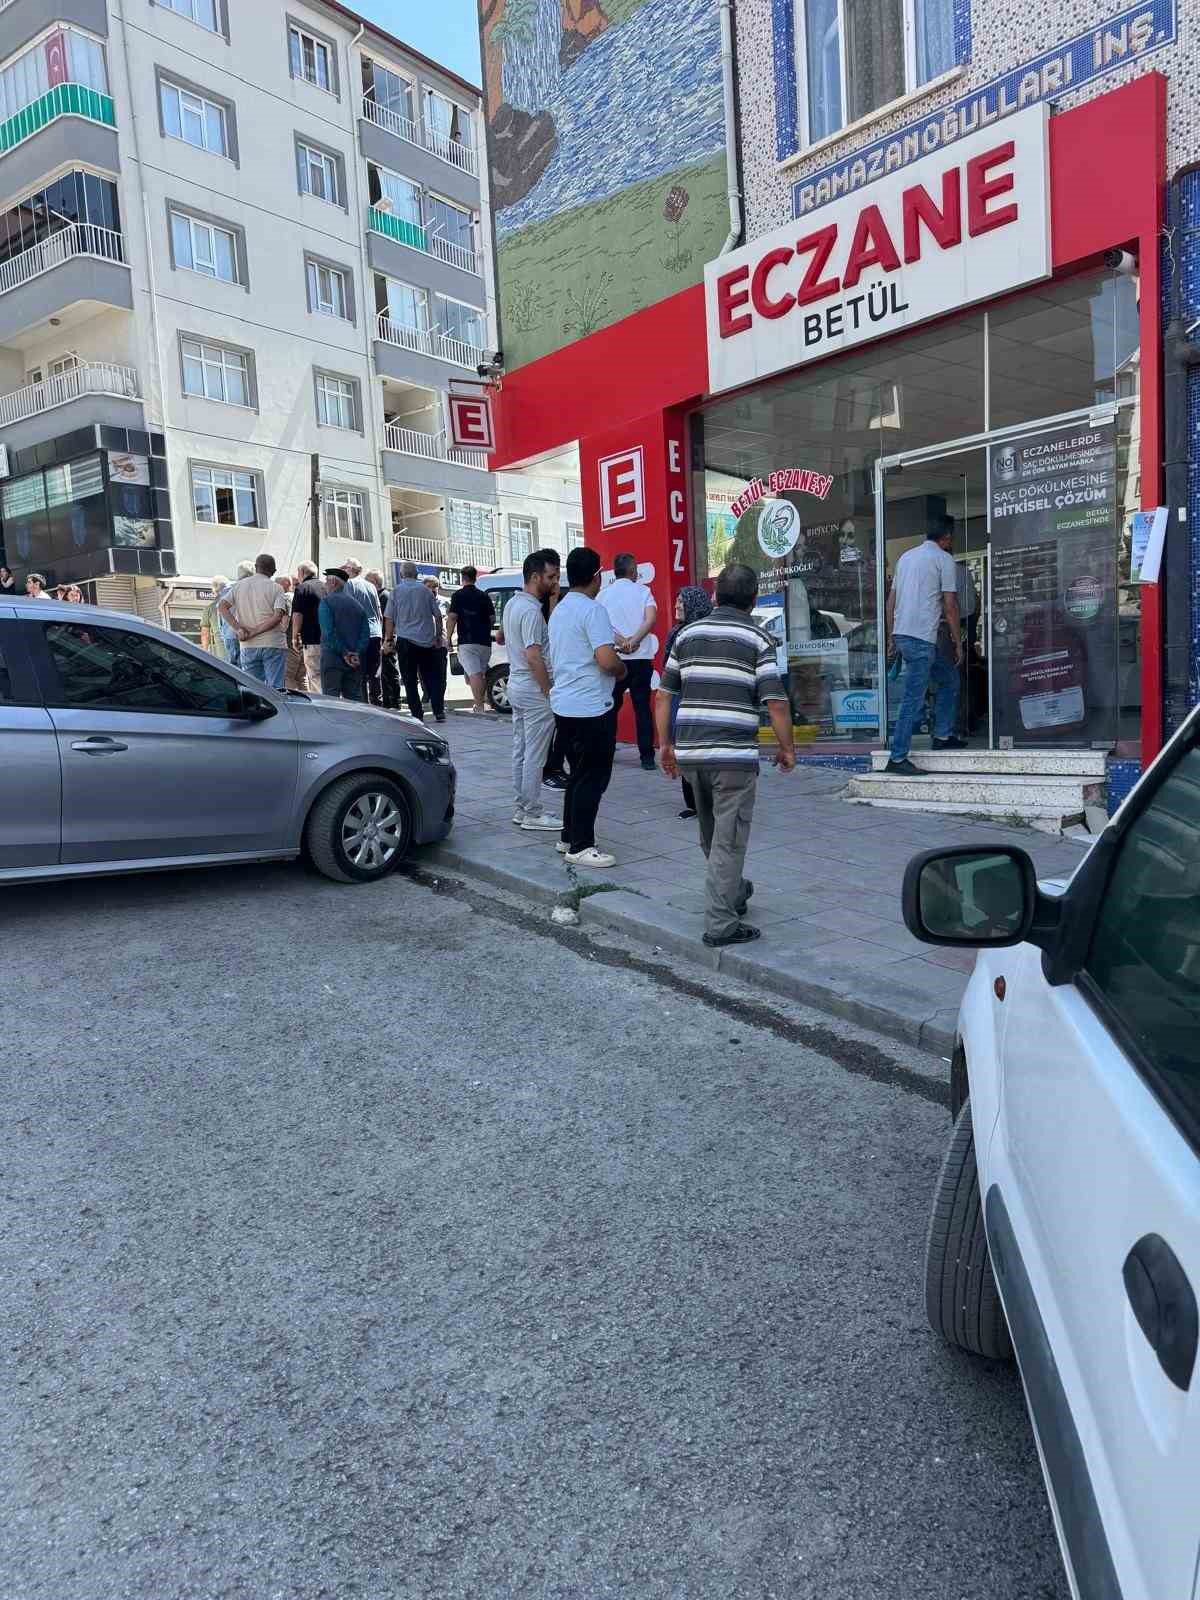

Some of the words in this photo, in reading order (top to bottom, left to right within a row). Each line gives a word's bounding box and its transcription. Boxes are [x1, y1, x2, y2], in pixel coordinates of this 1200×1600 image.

[800, 52, 1072, 211] RAMAZANOĞULLARI
[1093, 12, 1165, 69] İNŞ.
[717, 140, 1018, 339] ECZANE
[804, 281, 909, 346] BETÜL
[1023, 433, 1101, 458] ECZANELERDE
[730, 478, 767, 519] BETÜL
[768, 468, 834, 501] ECZANESİ
[993, 489, 1016, 503] SAÇ
[1018, 472, 1107, 498] DÖKÜLMESİNE
[994, 498, 1052, 518] BİTKİSEL
[1054, 488, 1107, 510] ÇÖZÜM
[846, 699, 866, 712] SGK
